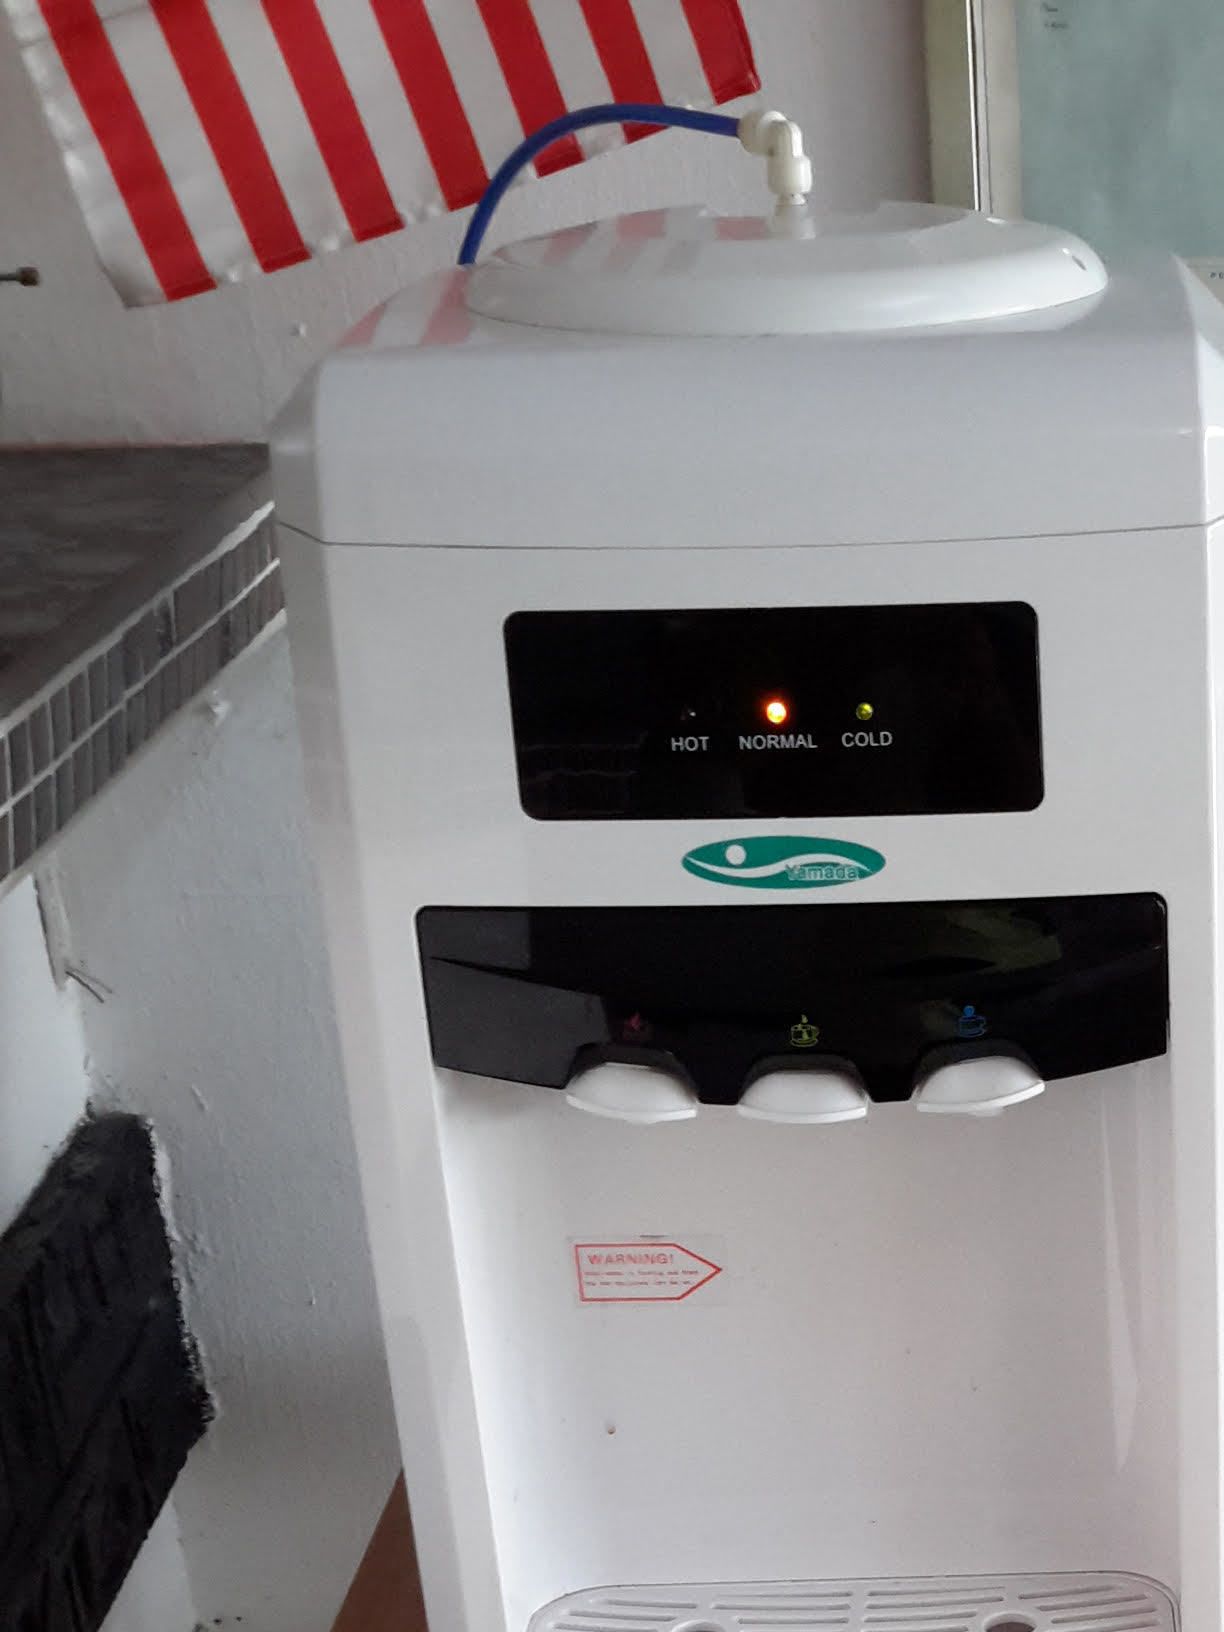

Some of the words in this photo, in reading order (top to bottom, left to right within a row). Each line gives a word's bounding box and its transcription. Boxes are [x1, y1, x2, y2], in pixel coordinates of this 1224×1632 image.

[670, 736, 710, 751] HOT
[739, 734, 818, 750] NORMAL
[841, 731, 893, 747] COLD
[785, 863, 860, 881] Yamada
[587, 1253, 674, 1264] WARNING!
